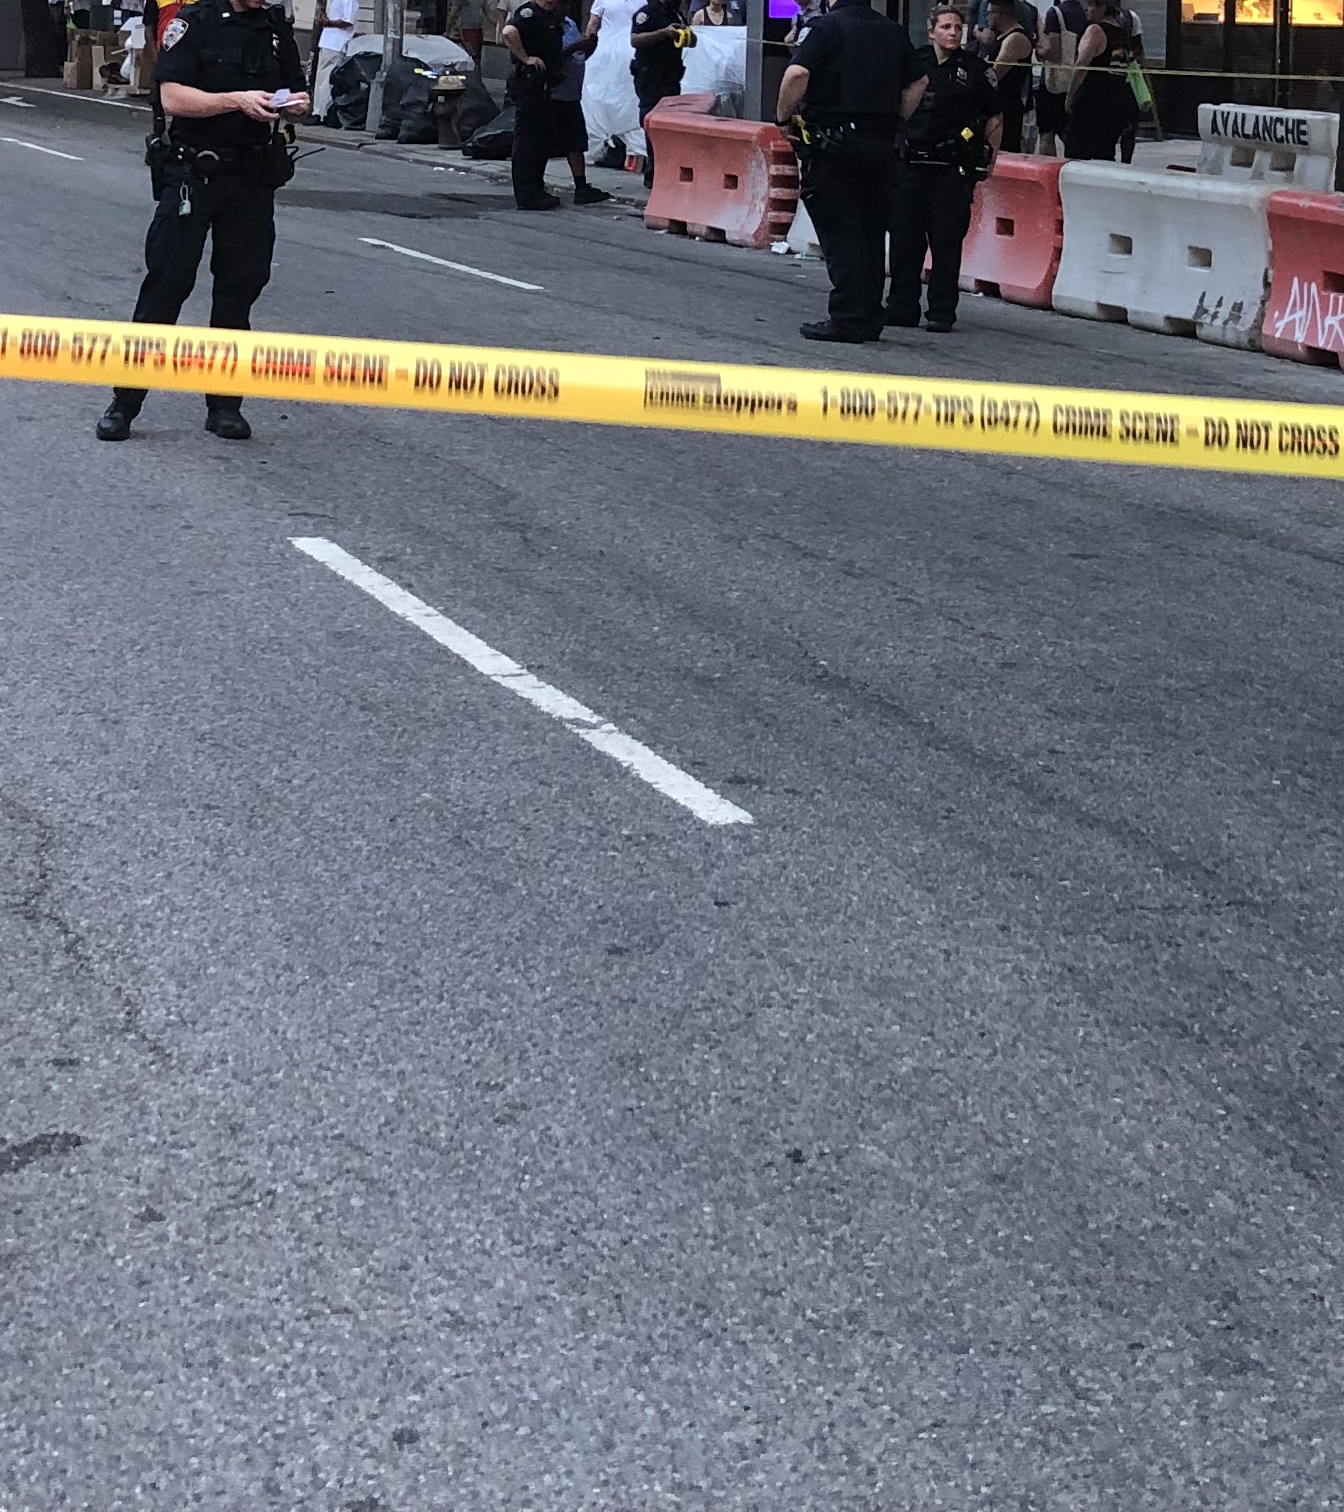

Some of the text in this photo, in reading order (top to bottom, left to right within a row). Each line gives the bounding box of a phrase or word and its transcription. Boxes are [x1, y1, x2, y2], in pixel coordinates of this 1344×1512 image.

[1210, 110, 1308, 146] AVALANCHE
[413, 356, 443, 395] DO
[448, 359, 488, 397] NOT
[493, 363, 560, 404] CROSS
[1052, 402, 1113, 440] CRIME
[1119, 408, 1179, 445] SCENE
[1203, 414, 1230, 450] DO
[1235, 416, 1272, 453] NOT
[1278, 420, 1340, 460] CROSS
